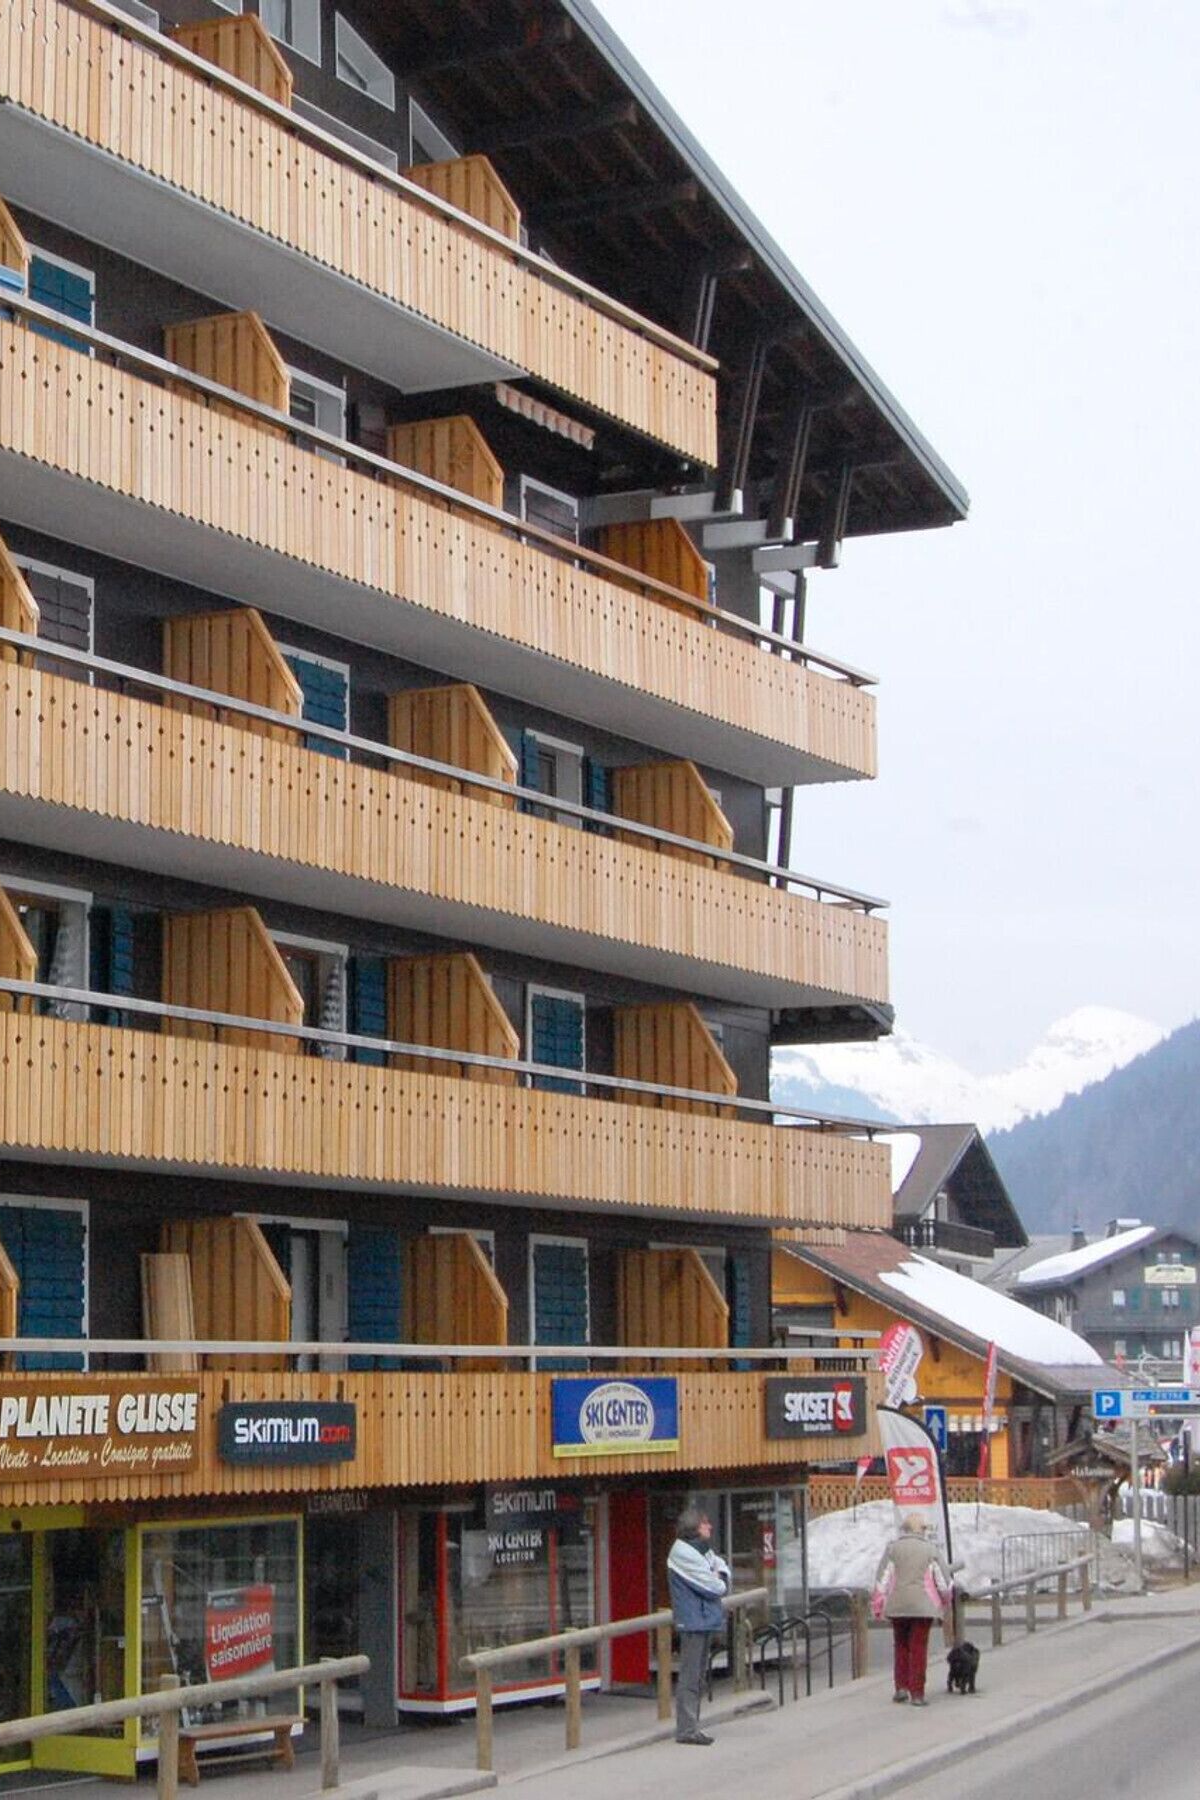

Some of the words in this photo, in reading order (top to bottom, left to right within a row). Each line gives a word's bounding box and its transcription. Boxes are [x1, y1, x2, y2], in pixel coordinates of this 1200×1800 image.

[0, 1395, 111, 1438] PLANETE
[116, 1392, 198, 1434] GLISSE
[585, 1401, 604, 1428] SKI
[605, 1399, 649, 1427] CENTER
[784, 1391, 836, 1422] SKISET
[1101, 1394, 1115, 1413] P
[39, 1440, 91, 1467] Location
[101, 1437, 149, 1469] Consigne
[151, 1441, 193, 1468] gratuite
[505, 1529, 542, 1549] CENTER
[496, 1551, 534, 1564] LOCATION
[211, 1611, 271, 1645] Liquidation
[211, 1634, 273, 1668] saisonnière
